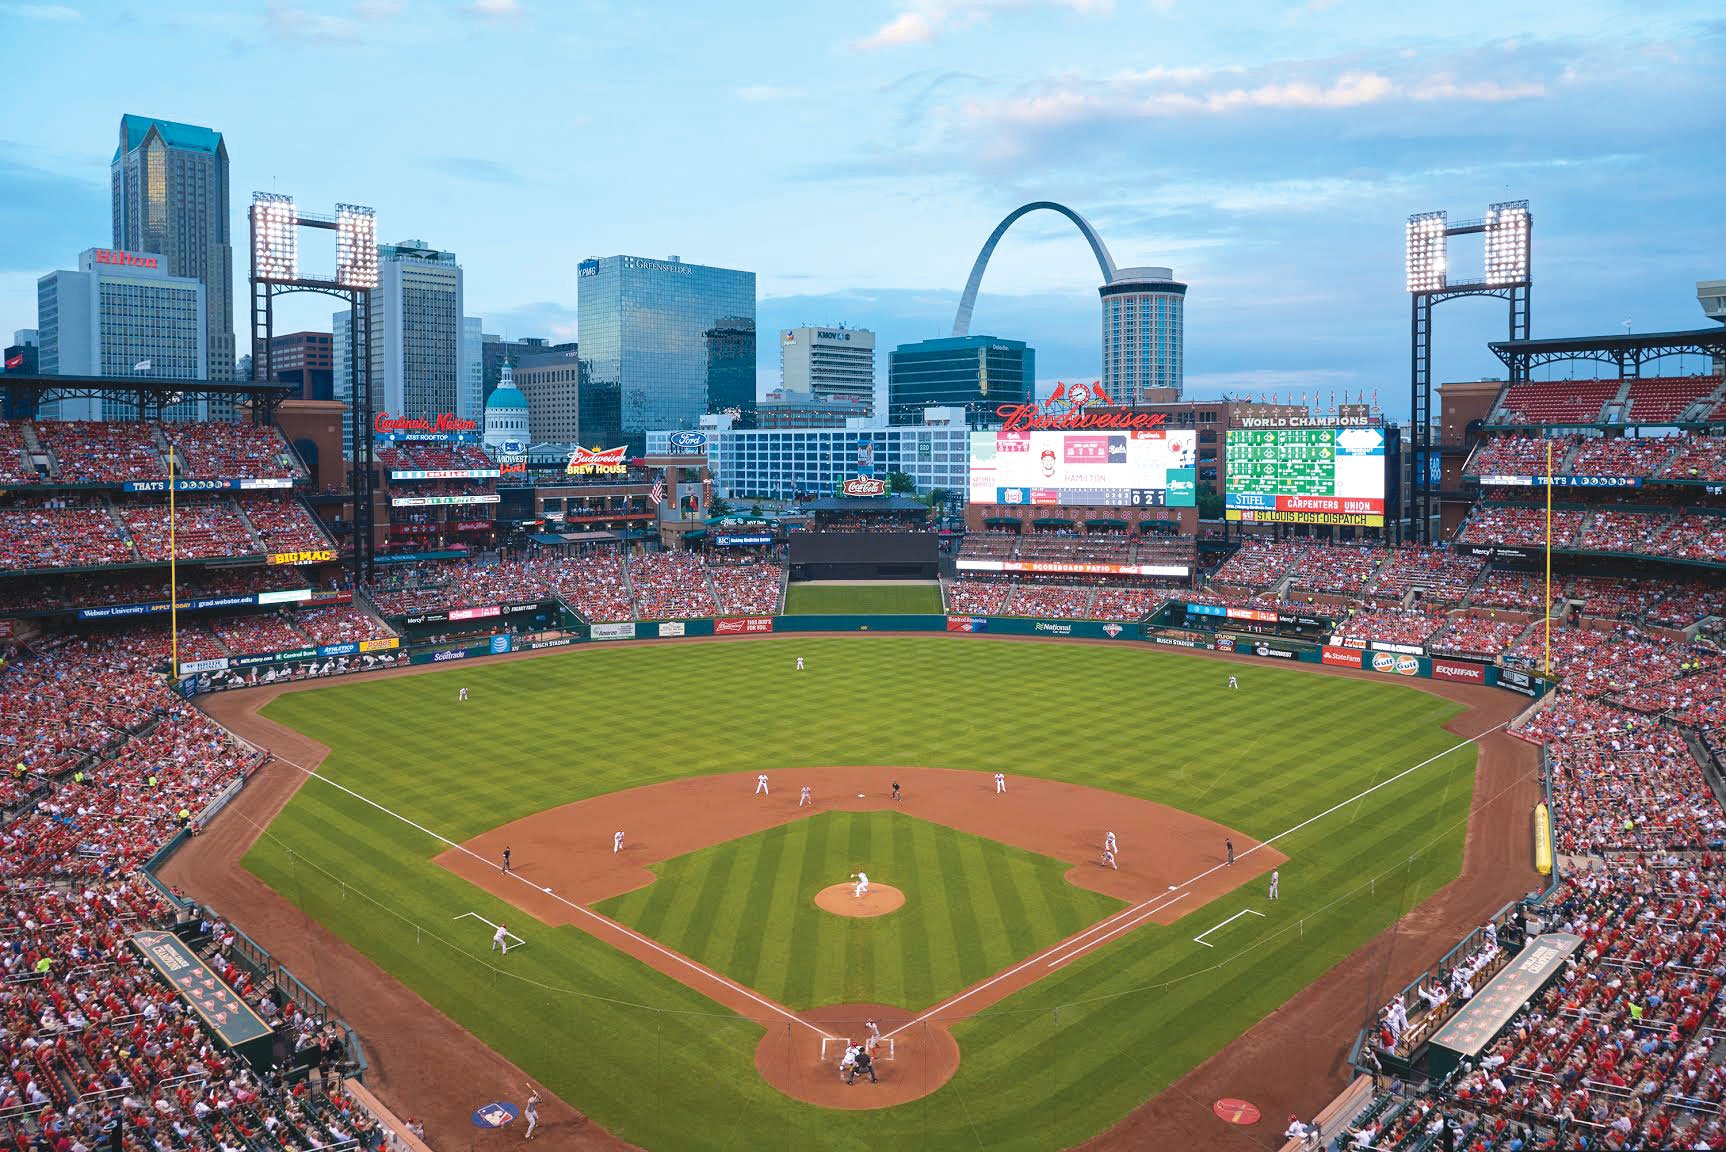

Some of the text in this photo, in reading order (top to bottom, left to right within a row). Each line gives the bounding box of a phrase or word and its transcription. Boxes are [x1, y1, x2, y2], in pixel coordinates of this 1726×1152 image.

[96, 249, 157, 268] Hilton
[818, 331, 837, 340] KMOV
[375, 412, 475, 433] Cardinals Nation
[996, 403, 1168, 433] Budweiser
[1242, 416, 1368, 427] WORLD CHAMPIONS
[679, 433, 701, 445] Ford
[1108, 444, 1127, 454] Reds
[496, 455, 528, 463] MIDWEST
[567, 452, 626, 465] Budweiser
[567, 465, 627, 475] BREW HOUSE
[133, 482, 164, 490] THAT'S
[180, 481, 223, 489] POWER
[1581, 477, 1626, 486] POWER
[848, 481, 880, 493] Coca-Cola
[1132, 495, 1164, 505] 0 2 1
[1236, 495, 1265, 505] STIFEL
[1287, 500, 1371, 511] CARPENTERS UNION
[1040, 509, 1049, 518] 10
[1257, 512, 1367, 525] ST. LOUIS POST-DISPATCH
[1472, 548, 1490, 556] Mercy
[275, 551, 330, 564] BIG MAC
[1033, 563, 1084, 572] SCOREBOARD
[1086, 564, 1110, 572] PATIO
[84, 609, 109, 617] Webster
[111, 605, 144, 615] University
[198, 595, 252, 608] grad.webster.edu
[407, 616, 422, 624] Mercy
[1043, 623, 1071, 632] National
[1156, 638, 1195, 648] BUSCH STADIUM
[324, 644, 354, 653] ATHLETICO
[434, 650, 465, 662] Scottrade
[1374, 657, 1416, 671] Gulf Gulf
[1436, 665, 1480, 679] EQUIFAX
